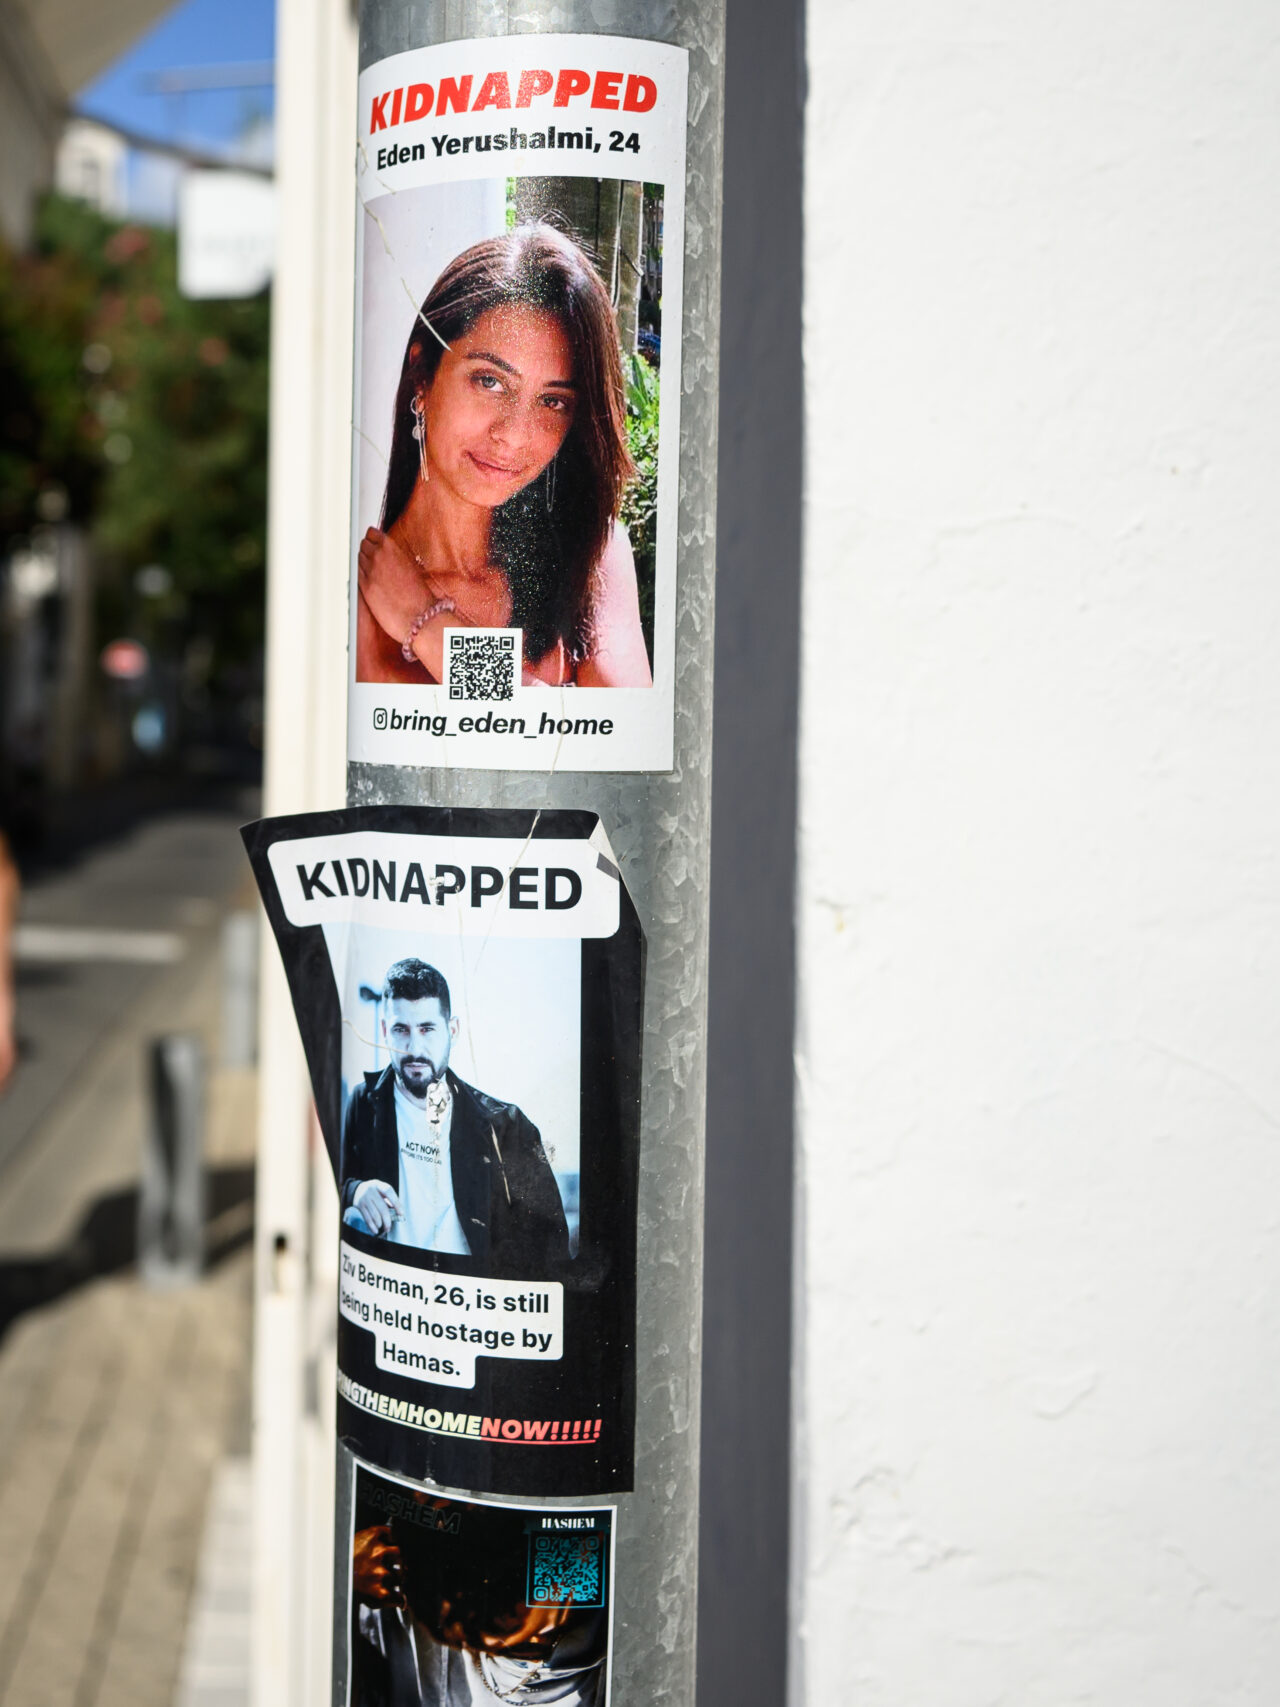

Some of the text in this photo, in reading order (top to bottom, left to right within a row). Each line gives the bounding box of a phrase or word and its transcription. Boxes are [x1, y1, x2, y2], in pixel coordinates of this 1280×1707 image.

[370, 69, 658, 135] KIDNAPPED
[377, 126, 640, 170] Eden Yerushalmi, 24
[390, 708, 614, 738] bring_eden_home
[296, 857, 583, 910] KIDNAPPED
[405, 1141, 419, 1152] ACT
[343, 1254, 549, 1313] Ziv Berman, 26, is still
[373, 1303, 412, 1331] held
[417, 1315, 515, 1350] hostage
[522, 1328, 553, 1353] by
[383, 1340, 461, 1376] Hamas.
[541, 1517, 595, 1529] HASHEM
